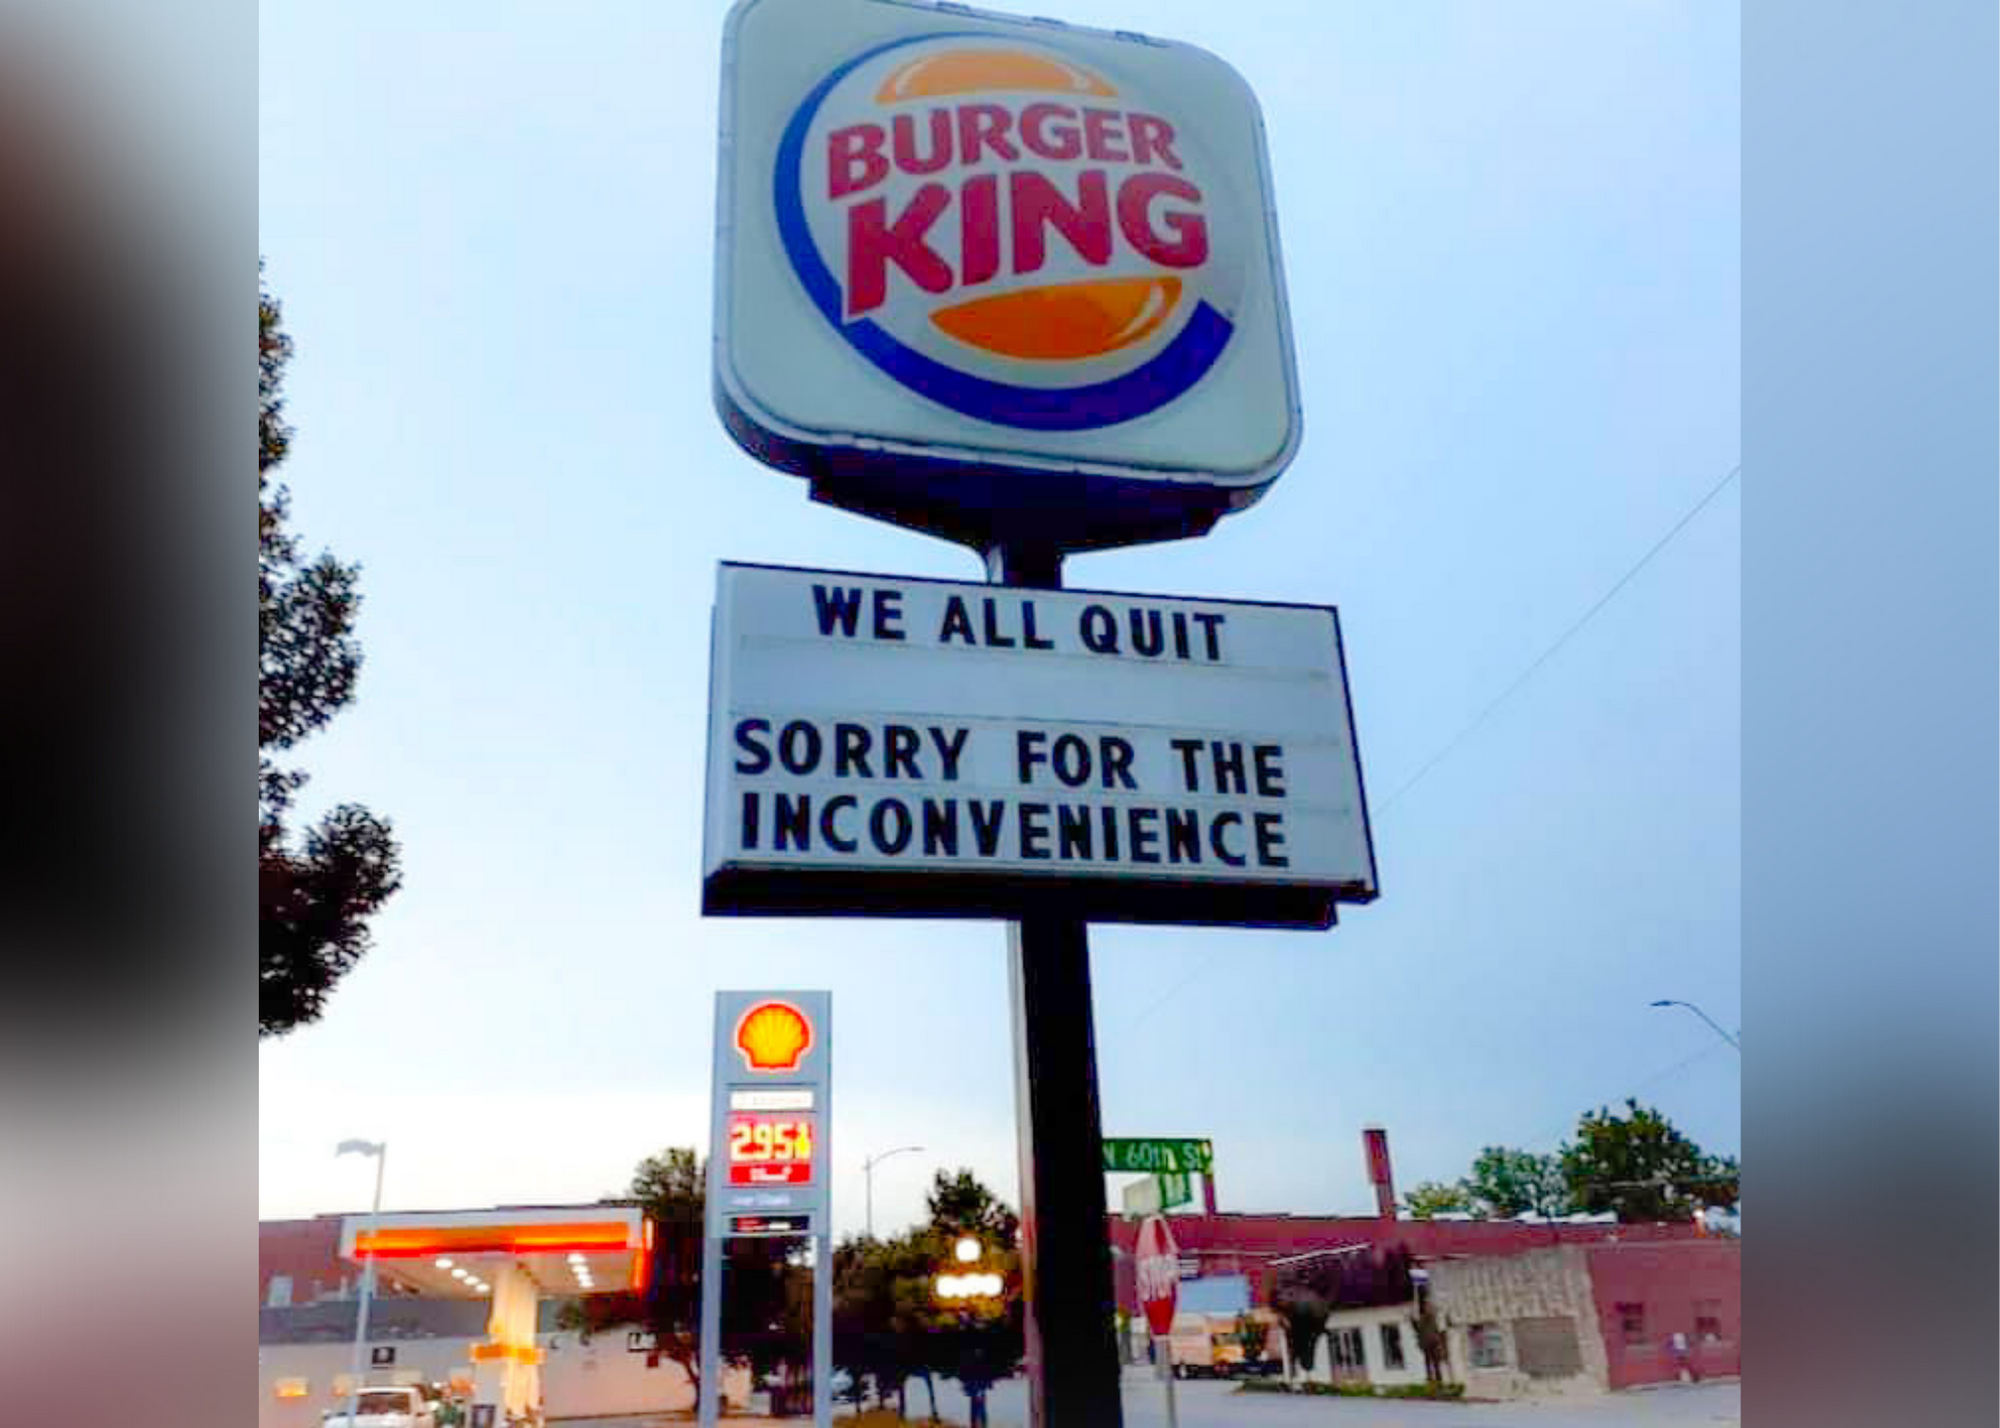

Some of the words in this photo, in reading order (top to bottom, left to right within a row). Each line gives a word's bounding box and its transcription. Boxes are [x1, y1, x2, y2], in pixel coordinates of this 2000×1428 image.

[828, 103, 1183, 200] BURGER
[847, 169, 1208, 316] KING
[811, 584, 905, 641] WE
[939, 595, 1055, 651] ALL
[1079, 605, 1225, 661] QUIT
[733, 718, 969, 780] SORRY
[1016, 730, 1137, 790] FOR
[1170, 739, 1286, 798] THE
[740, 792, 1290, 867] INCONVENIENCE
